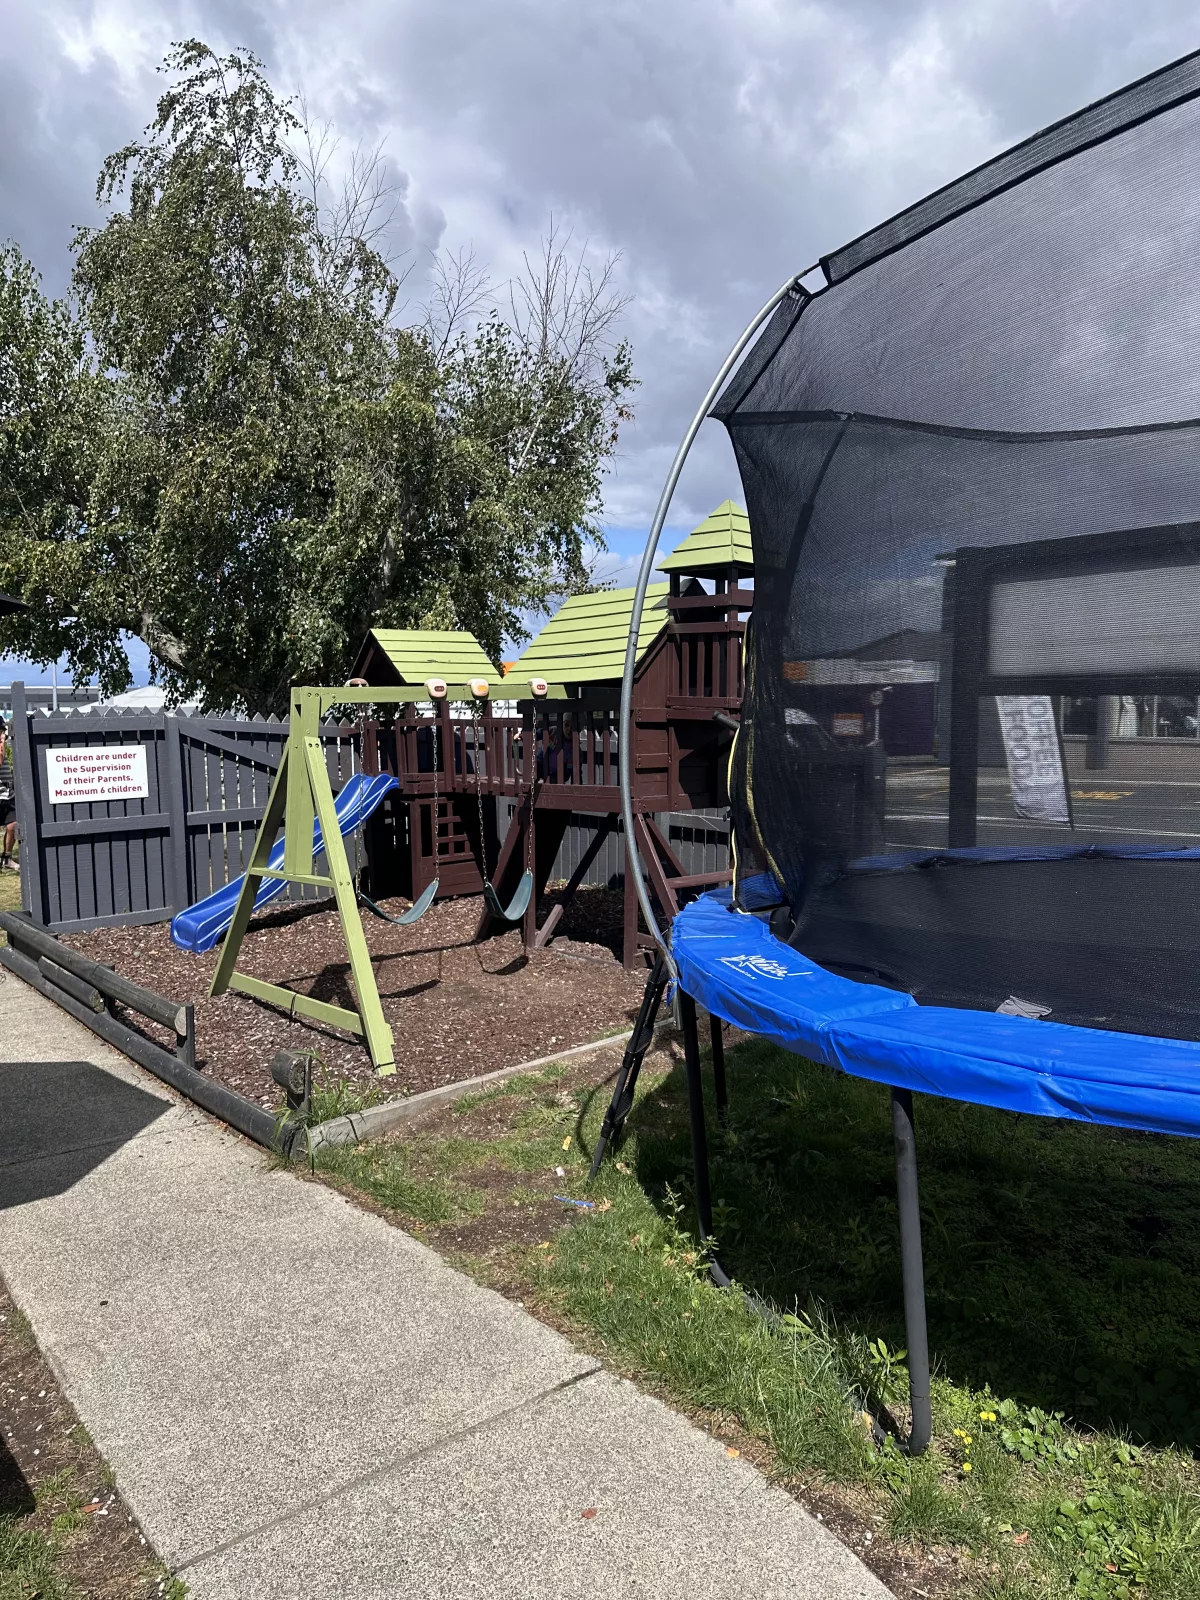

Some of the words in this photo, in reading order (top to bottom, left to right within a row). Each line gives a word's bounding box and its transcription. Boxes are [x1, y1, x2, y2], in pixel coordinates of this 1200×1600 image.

[1027, 696, 1058, 778] OFFEE
[1004, 710, 1034, 780] FOOD
[55, 754, 94, 763] Children
[95, 753, 110, 761] are
[112, 752, 137, 760] under
[63, 766, 78, 774] the
[80, 764, 131, 774] Supervision
[63, 777, 72, 785] of
[74, 776, 96, 784] their
[97, 775, 134, 783] Parents.
[55, 788, 98, 797] Maximum
[100, 786, 106, 794] 6
[107, 785, 142, 794] children
